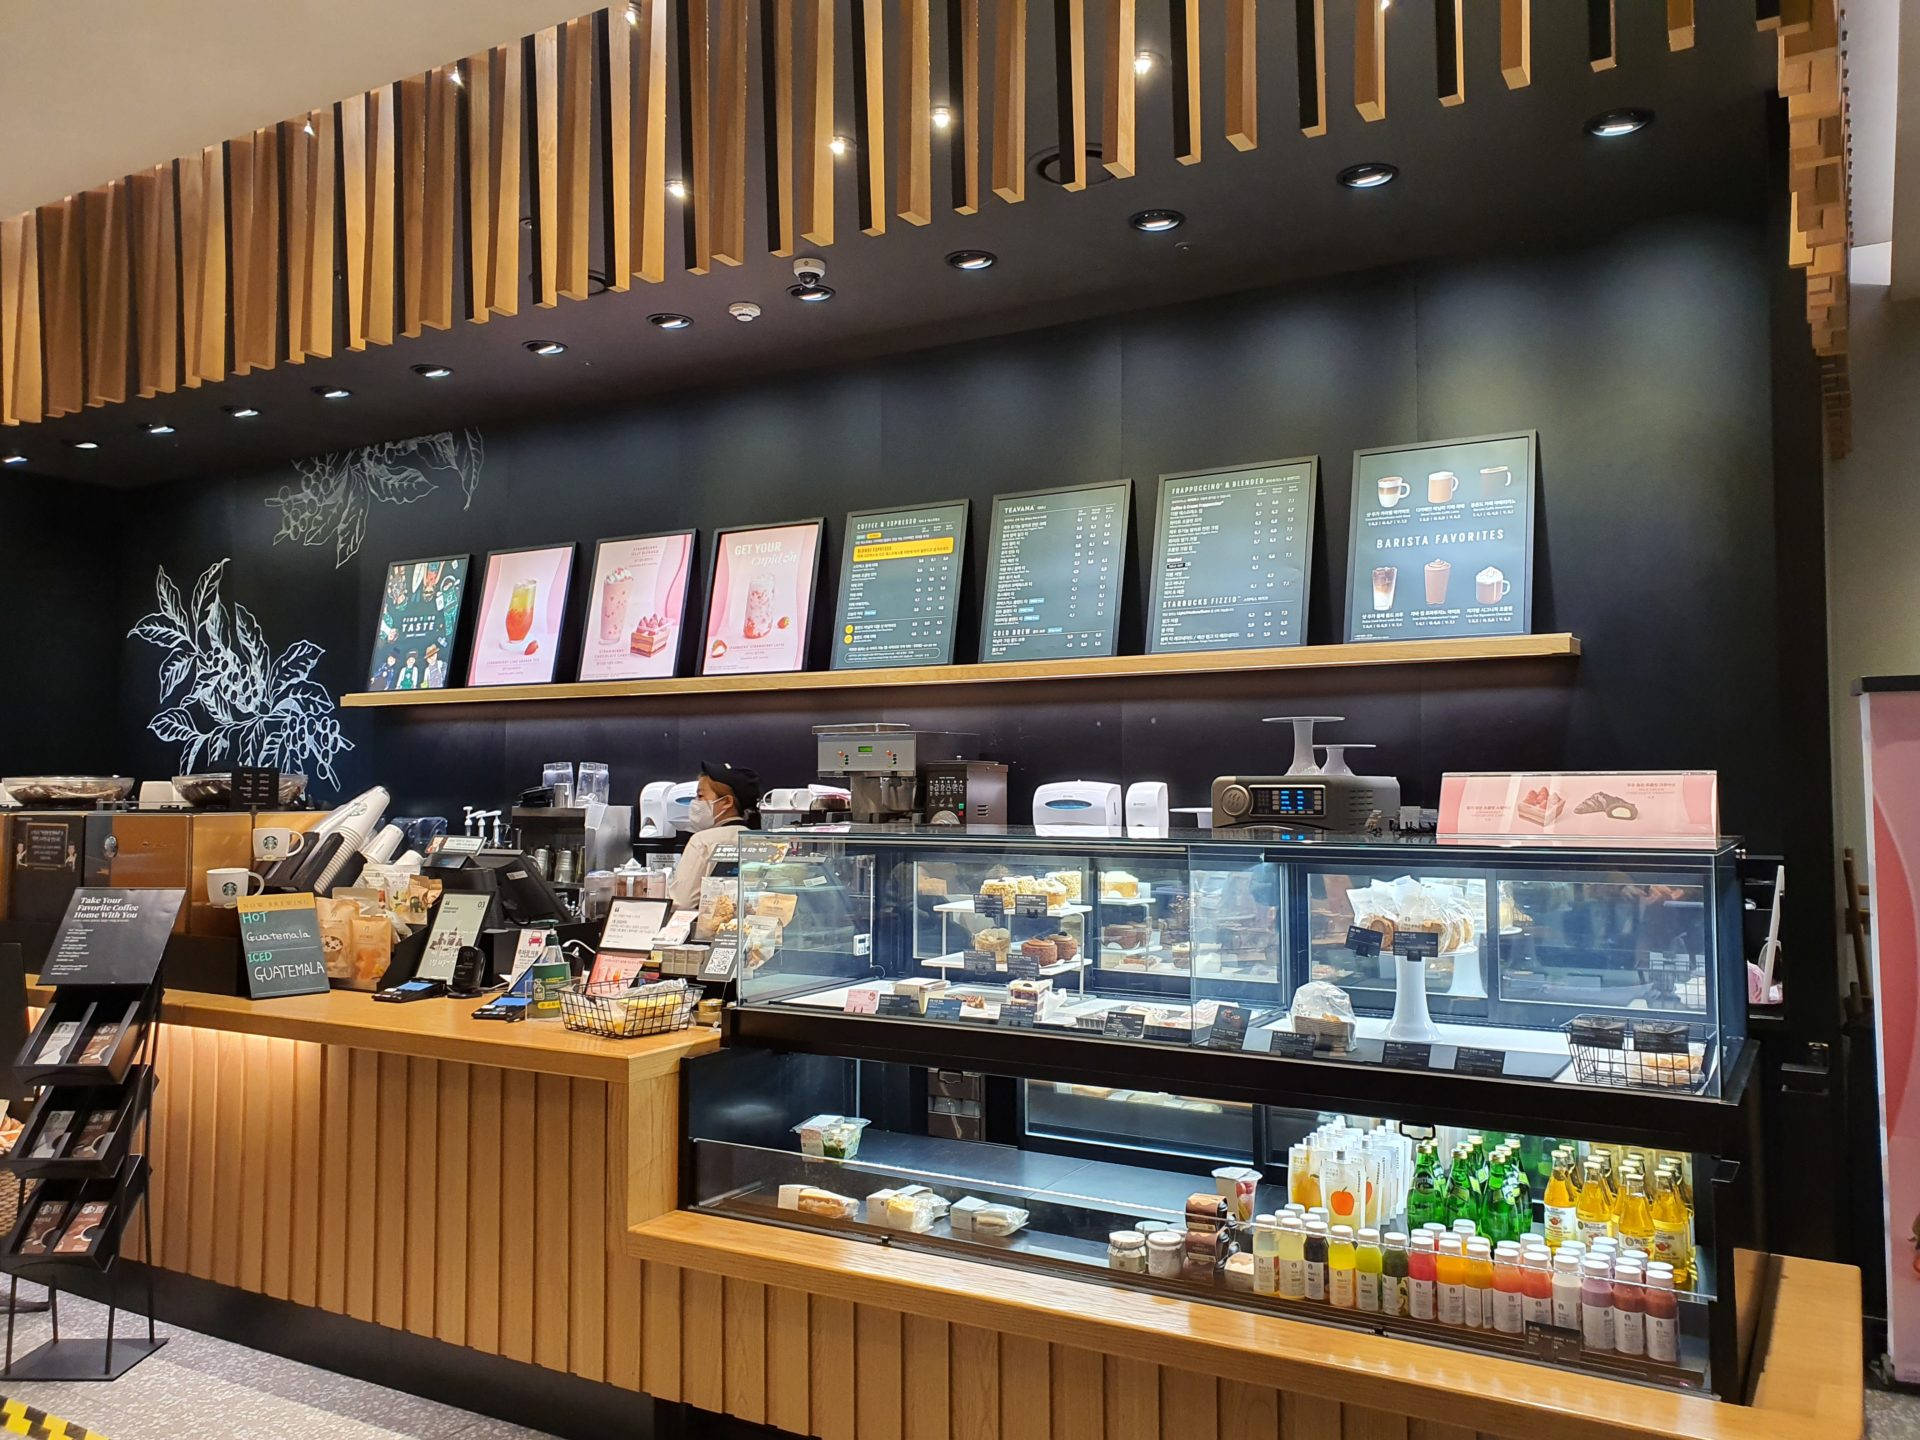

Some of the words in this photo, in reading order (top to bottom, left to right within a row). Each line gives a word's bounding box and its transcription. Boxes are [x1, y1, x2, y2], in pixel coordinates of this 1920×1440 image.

[1004, 505, 1034, 513] TEAVANA
[1376, 536, 1428, 548] BARISTA
[1435, 529, 1504, 544] FAVORITES
[735, 544, 752, 555] GET
[755, 541, 781, 553] YOUR
[402, 622, 434, 632] TASTE
[242, 911, 268, 923] HOT
[246, 929, 311, 942] Guatemala
[248, 951, 272, 963] ICED
[254, 961, 325, 983] GUATEMALA
